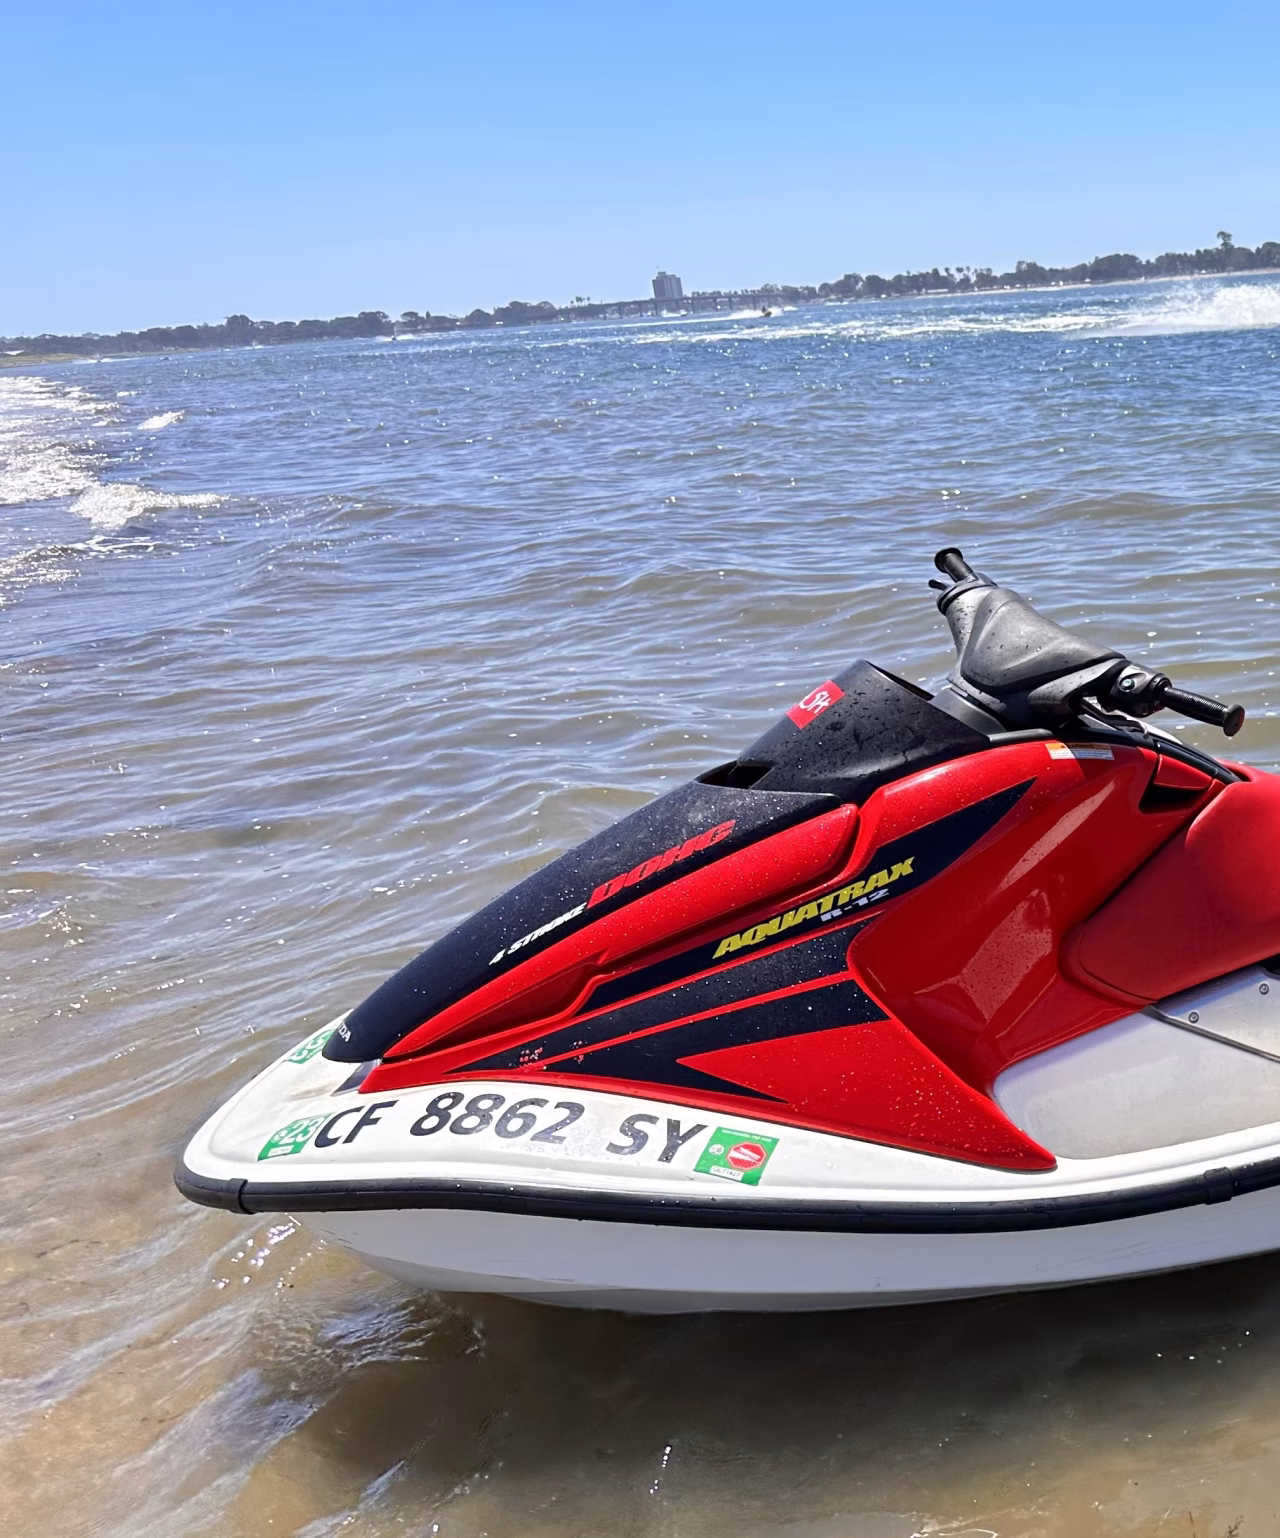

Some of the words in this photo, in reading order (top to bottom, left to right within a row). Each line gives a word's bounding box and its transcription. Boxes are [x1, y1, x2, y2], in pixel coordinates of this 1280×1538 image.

[489, 948, 507, 966] 4
[507, 901, 588, 955] STROKE
[586, 819, 737, 910] DOHC
[711, 855, 915, 960] AQUATRAX
[313, 1099, 400, 1149] CF
[409, 1091, 585, 1145] 8862
[604, 1113, 709, 1164] SY
